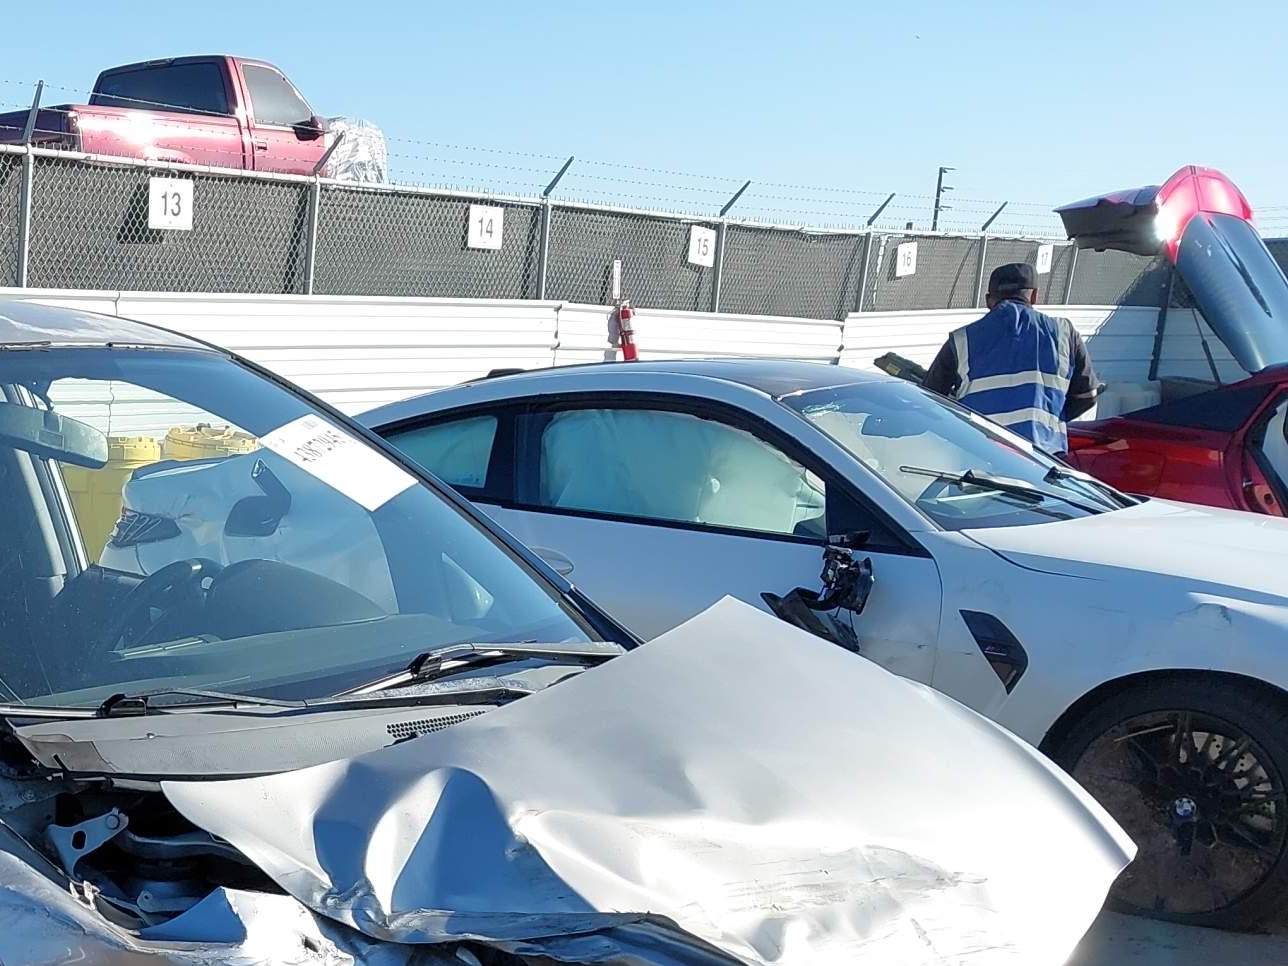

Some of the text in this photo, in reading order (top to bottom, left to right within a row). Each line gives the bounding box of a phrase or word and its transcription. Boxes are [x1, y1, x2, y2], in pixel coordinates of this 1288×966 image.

[161, 192, 181, 216] 13
[478, 217, 493, 237] 14
[697, 237, 709, 256] 15
[902, 251, 912, 267] 16
